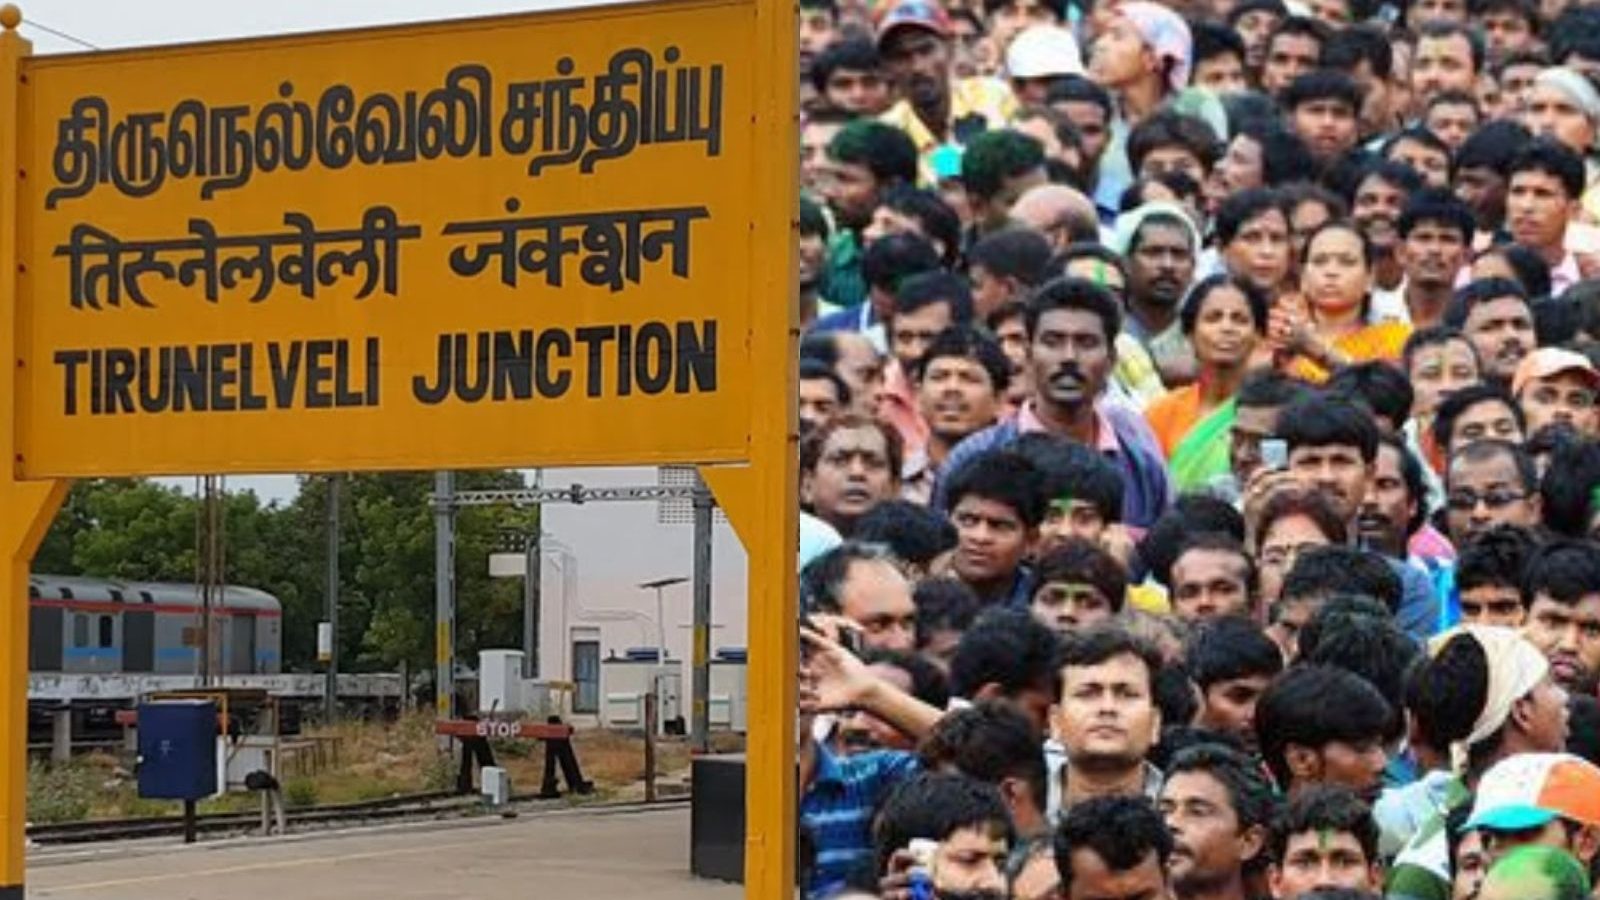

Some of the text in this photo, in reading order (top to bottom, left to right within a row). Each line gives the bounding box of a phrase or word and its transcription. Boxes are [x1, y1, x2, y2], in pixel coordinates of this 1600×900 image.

[46, 46, 723, 209] திருநெல்வேலி சந்திப்பு
[442, 198, 710, 292] जंक्शन
[54, 320, 717, 416] TIRUNELVELI JUNCTION
[476, 720, 521, 737] STOP
